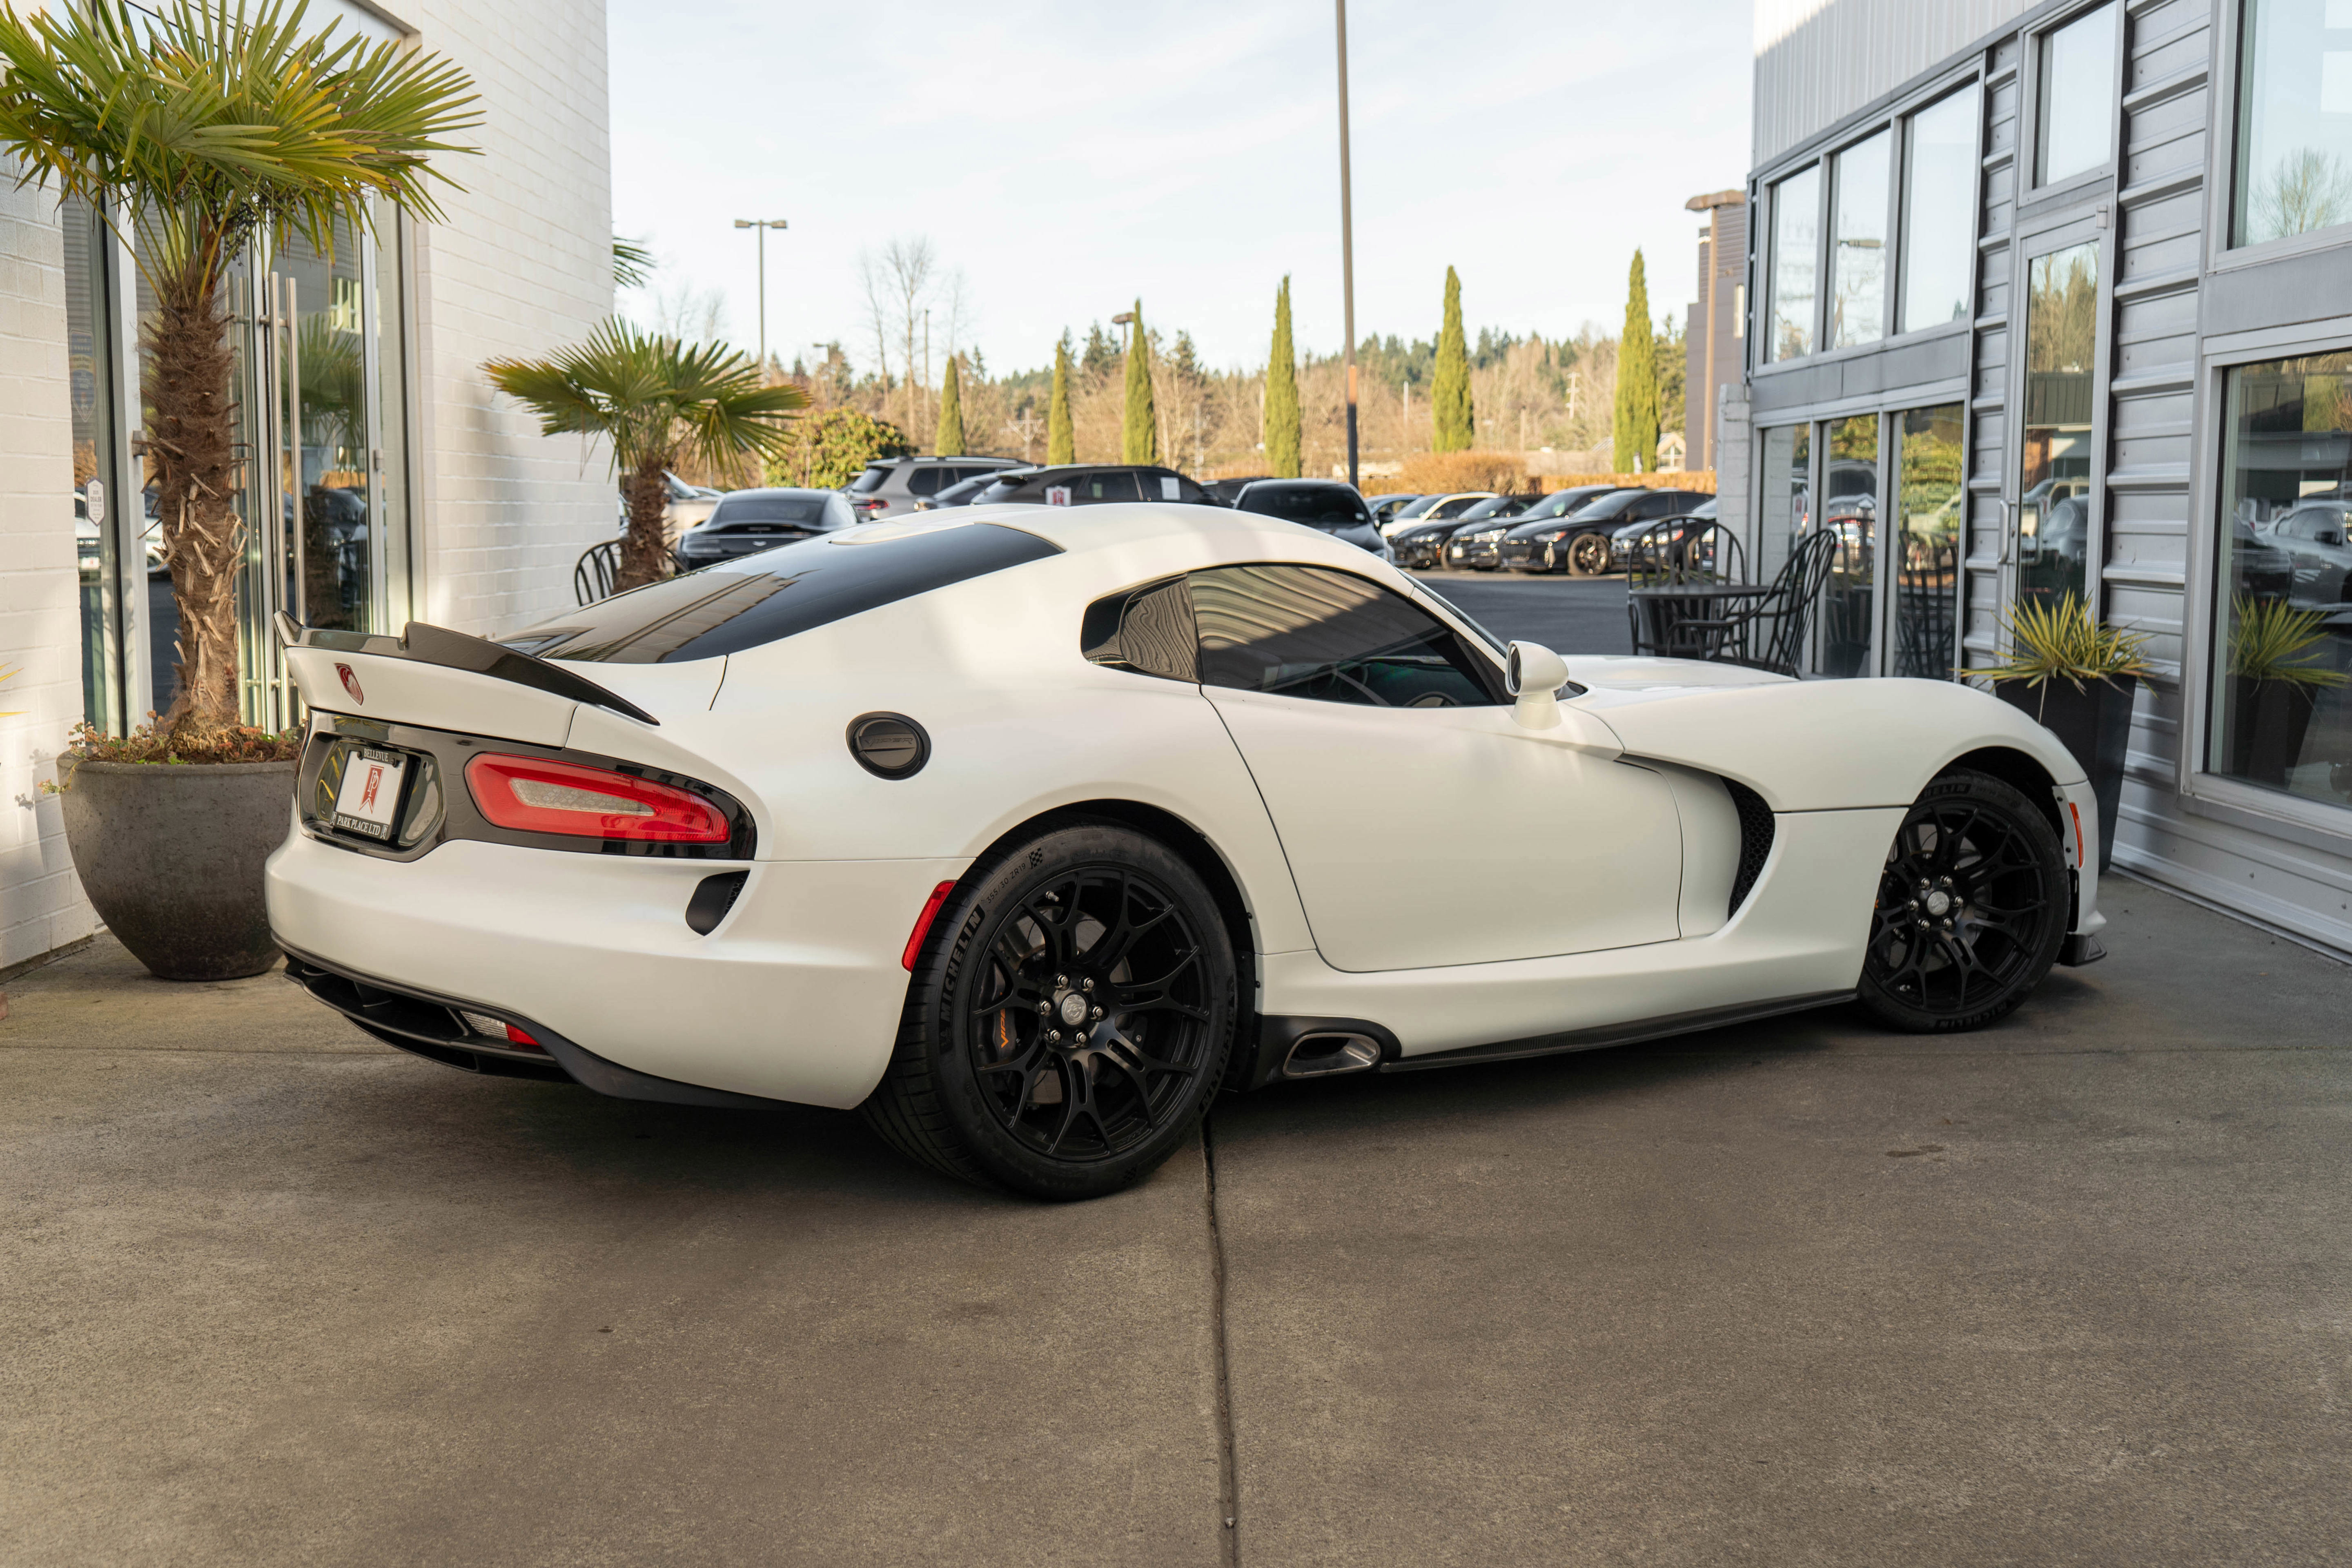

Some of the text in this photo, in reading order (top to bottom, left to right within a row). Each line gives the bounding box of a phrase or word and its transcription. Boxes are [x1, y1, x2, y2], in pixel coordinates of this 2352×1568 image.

[864, 737, 913, 747] VIPER
[364, 748, 389, 762] BELLEVUE
[1924, 784, 1967, 797] HELIN
[336, 815, 350, 828] PARK
[350, 819, 368, 833] PLACE
[368, 824, 381, 835] LTD
[940, 862, 1026, 1022] MICHELIN 355/30 ZR19
[1000, 992, 1009, 1049] VIPE
